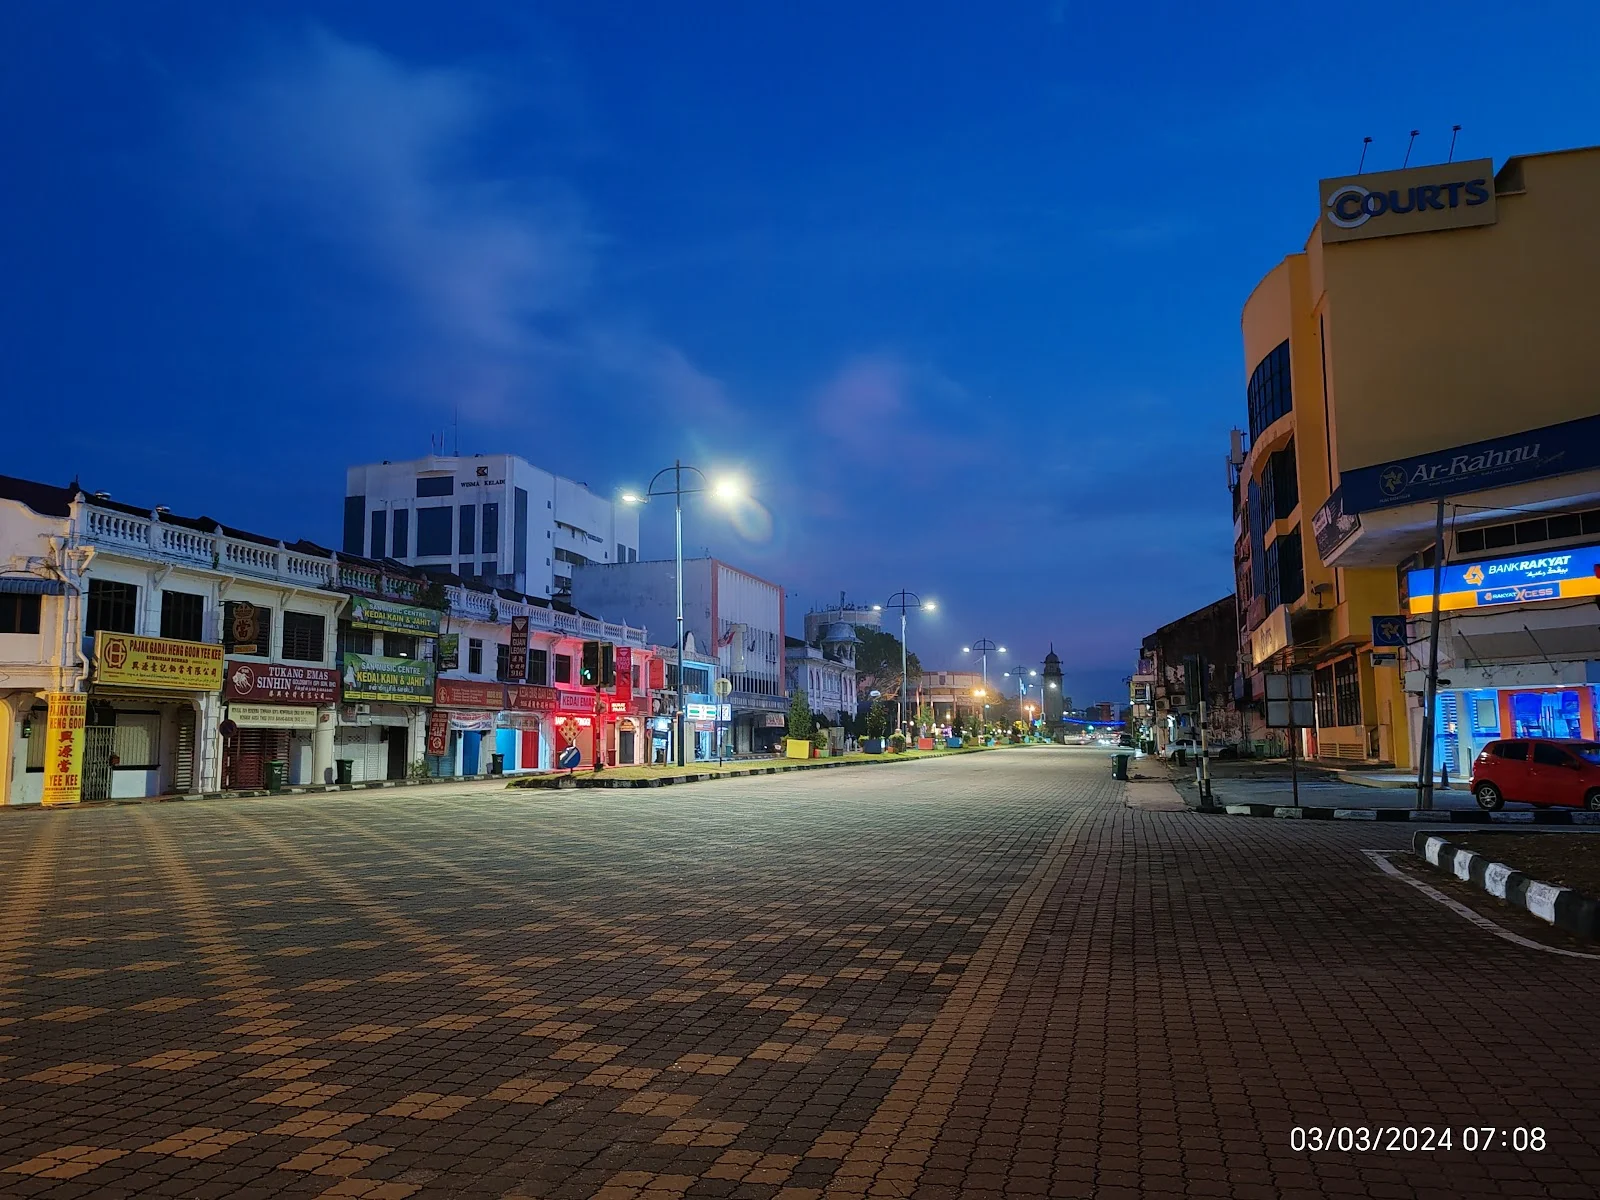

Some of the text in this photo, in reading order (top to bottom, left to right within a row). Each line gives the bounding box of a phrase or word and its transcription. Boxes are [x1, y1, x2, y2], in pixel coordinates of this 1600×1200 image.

[1328, 179, 1490, 228] COURTS
[1409, 443, 1541, 484] Ar-Rahnu
[364, 610, 386, 619] KEDAI
[387, 613, 404, 622] KAIN
[412, 617, 432, 626] JAHIT
[380, 606, 402, 614] MUSIC
[403, 609, 426, 618] CENTRE
[129, 639, 149, 653] PAJAK
[150, 642, 167, 655] GADAI
[168, 643, 184, 656] HENG
[185, 645, 200, 658] GOON
[201, 647, 211, 659] YEE
[211, 649, 222, 661] KEE
[268, 666, 329, 680] TUKANG EMAS
[374, 663, 397, 672] MUSIC
[397, 665, 420, 675] CENTRE
[510, 670, 524, 678] 916
[257, 676, 291, 690] SINHIN
[356, 671, 426, 687] KEDAI KAIN & JAHIT
[562, 695, 579, 706] KEDAI
[49, 704, 69, 717] PAJAK
[49, 717, 67, 729] HENG
[49, 775, 78, 786] YEE KEE
